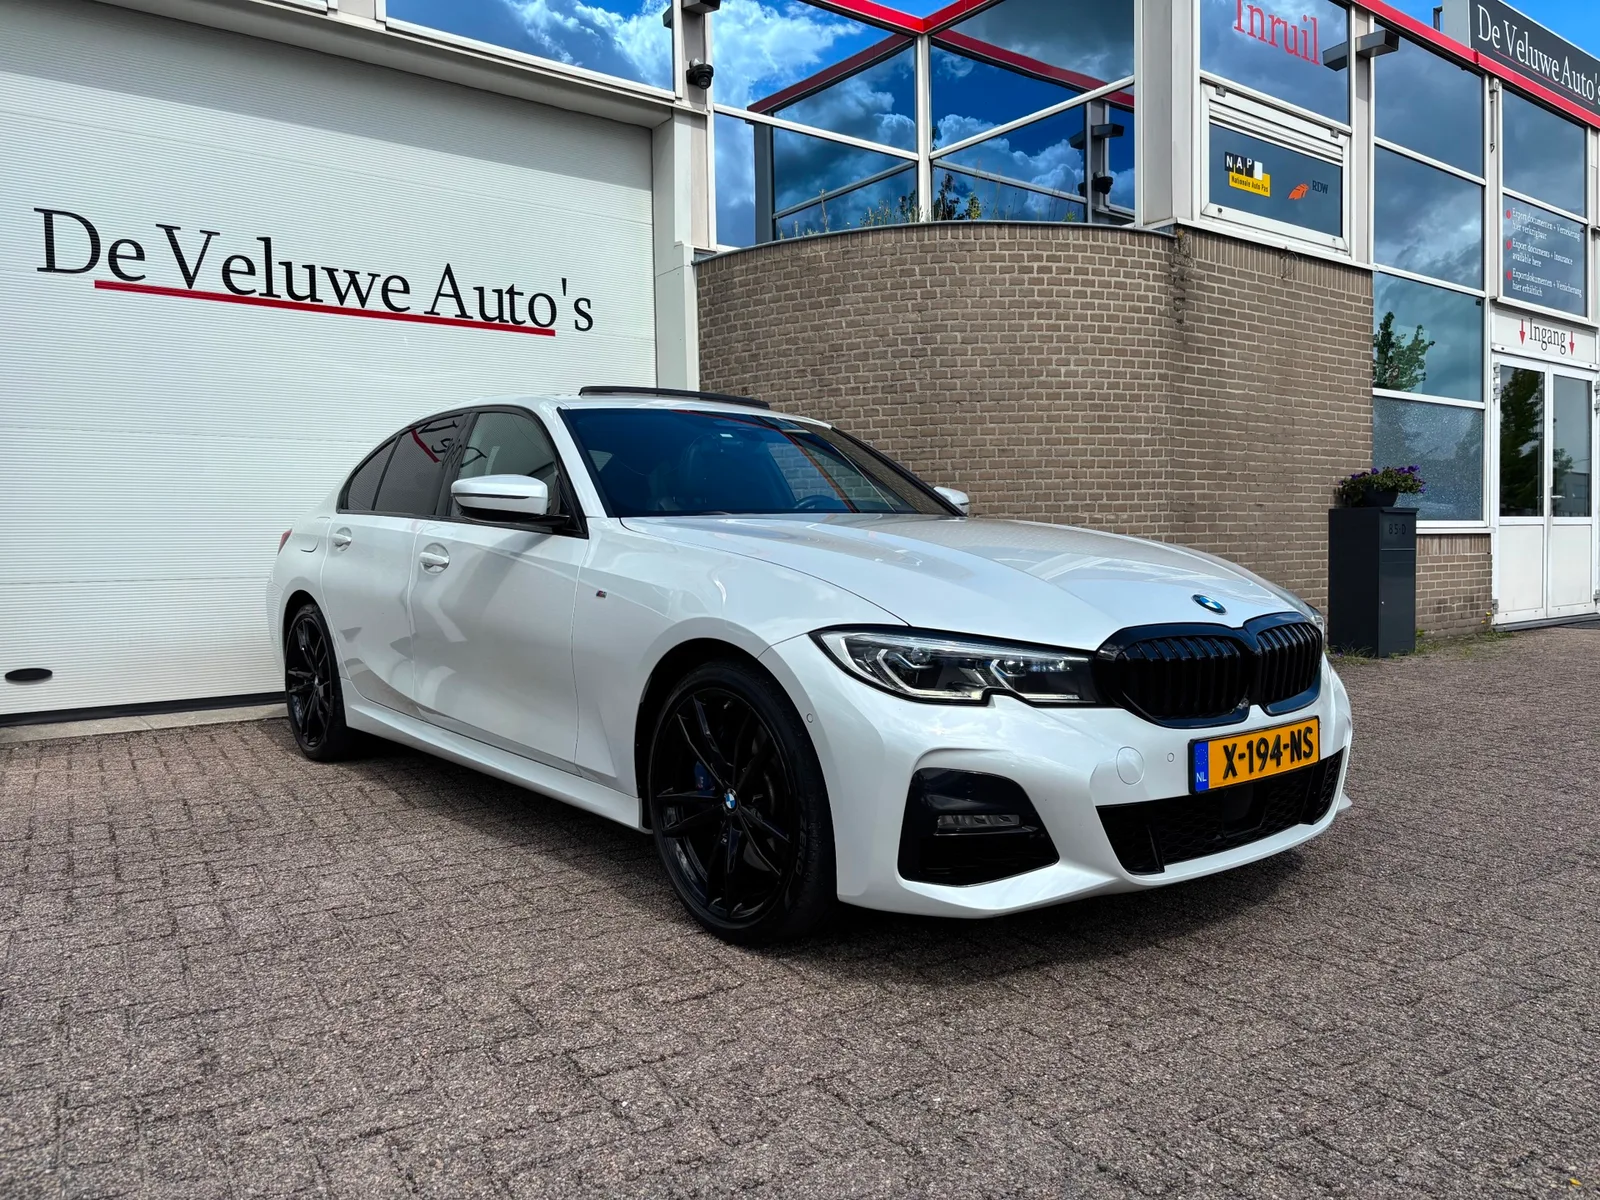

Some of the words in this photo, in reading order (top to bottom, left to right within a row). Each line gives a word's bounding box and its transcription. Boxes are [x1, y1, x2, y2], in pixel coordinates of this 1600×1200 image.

[1233, 0, 1320, 66] Inruil
[1477, 4, 1501, 49] De
[1503, 20, 1560, 82] Veluwe
[1226, 155, 1253, 169] NAP
[1231, 175, 1251, 188] Nationale
[1251, 180, 1261, 190] Auto
[1312, 180, 1329, 194] RDW
[1512, 238, 1527, 252] Export
[34, 207, 147, 282] De
[156, 223, 411, 313] Veluwe
[423, 262, 594, 332] Auto's
[1532, 256, 1542, 268] here
[1529, 317, 1567, 356] Ingang
[1222, 726, 1314, 780] X-194-NS
[1196, 771, 1207, 783] NL
